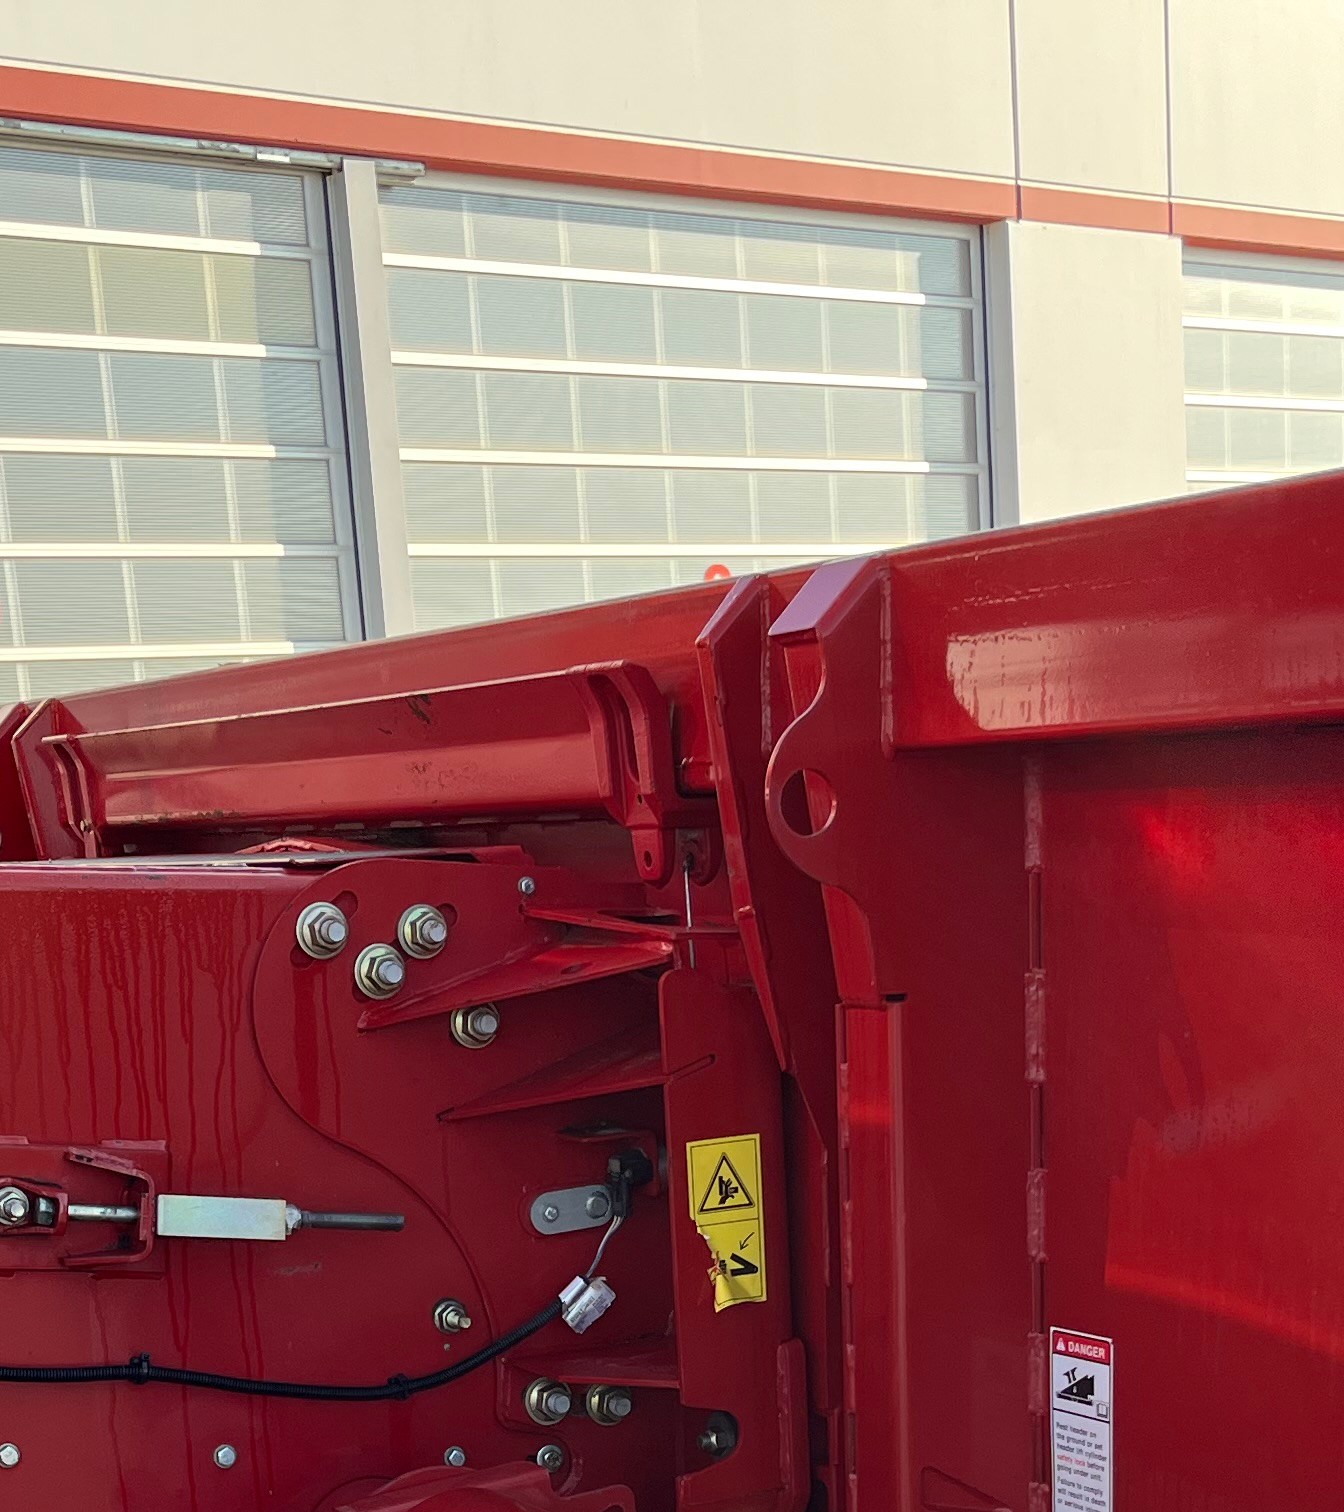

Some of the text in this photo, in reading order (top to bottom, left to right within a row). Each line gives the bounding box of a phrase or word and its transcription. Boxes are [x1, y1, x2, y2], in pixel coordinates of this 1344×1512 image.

[1067, 1340, 1106, 1359] DANGER
[1056, 1432, 1065, 1440] the
[1066, 1436, 1086, 1446] ground
[1070, 1426, 1088, 1436] header
[1056, 1443, 1074, 1453] header
[1085, 1452, 1107, 1462] cylinder
[1057, 1454, 1073, 1464] safety
[1087, 1461, 1105, 1472] before
[1057, 1464, 1072, 1475] going
[1073, 1469, 1089, 1478] under
[1057, 1476, 1076, 1488] Failure
[1083, 1486, 1103, 1497] comply
[1064, 1500, 1084, 1511] serious
[1068, 1491, 1083, 1500] result
[1091, 1497, 1106, 1507] death
